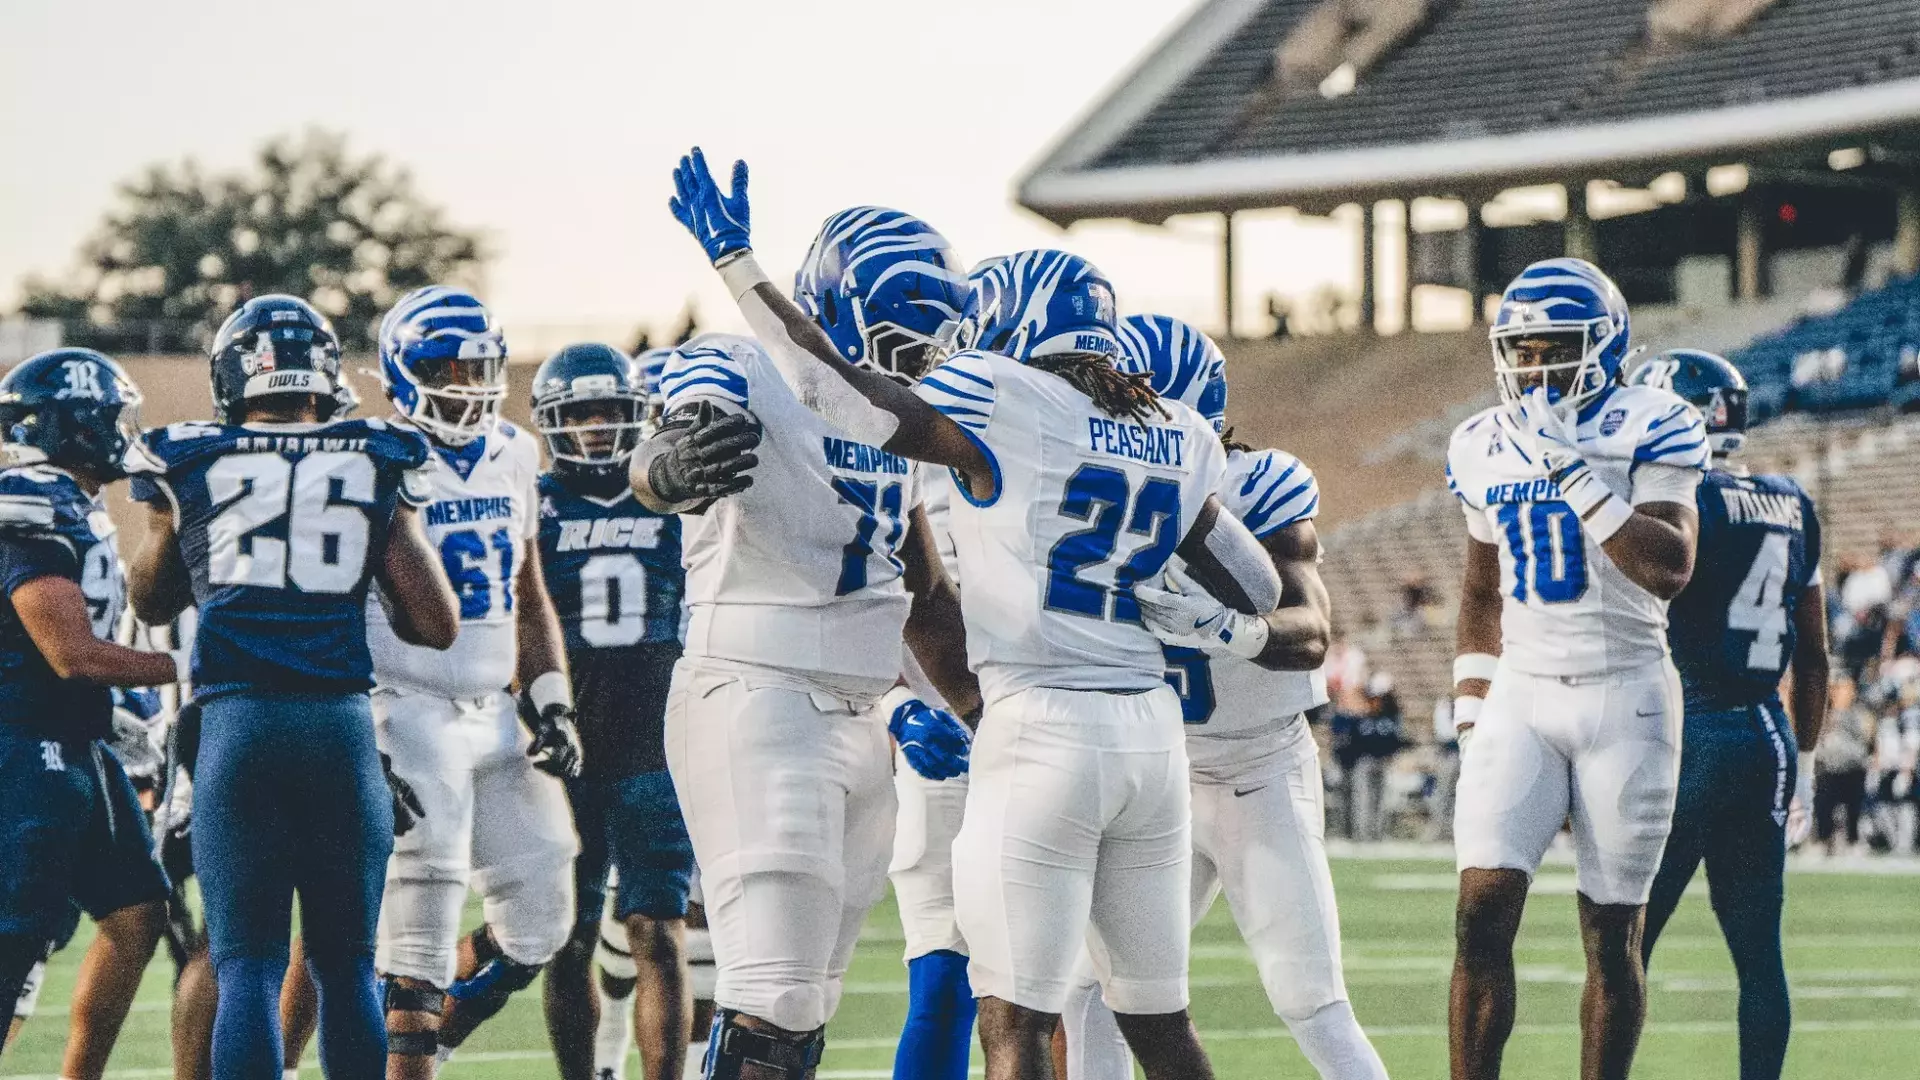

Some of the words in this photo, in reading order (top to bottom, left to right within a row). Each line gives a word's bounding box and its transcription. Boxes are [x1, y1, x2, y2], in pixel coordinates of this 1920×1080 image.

[1074, 335, 1119, 356] MEMP
[55, 360, 103, 400] R
[268, 373, 310, 389] OWLS
[823, 436, 908, 475] MEMPHIS
[1088, 416, 1185, 466] PEASANT
[426, 497, 512, 526] MEMPHIS
[1486, 478, 1561, 505] MEMPH
[1720, 488, 1803, 531] WILLIAMS
[206, 452, 375, 593] 26
[556, 516, 664, 552] RICE
[831, 475, 904, 596] 71
[1043, 462, 1182, 630] 22
[1497, 500, 1590, 605] 10
[441, 526, 514, 620] 61
[580, 553, 649, 648] 0
[1728, 531, 1791, 671] 4
[40, 740, 66, 771] R
